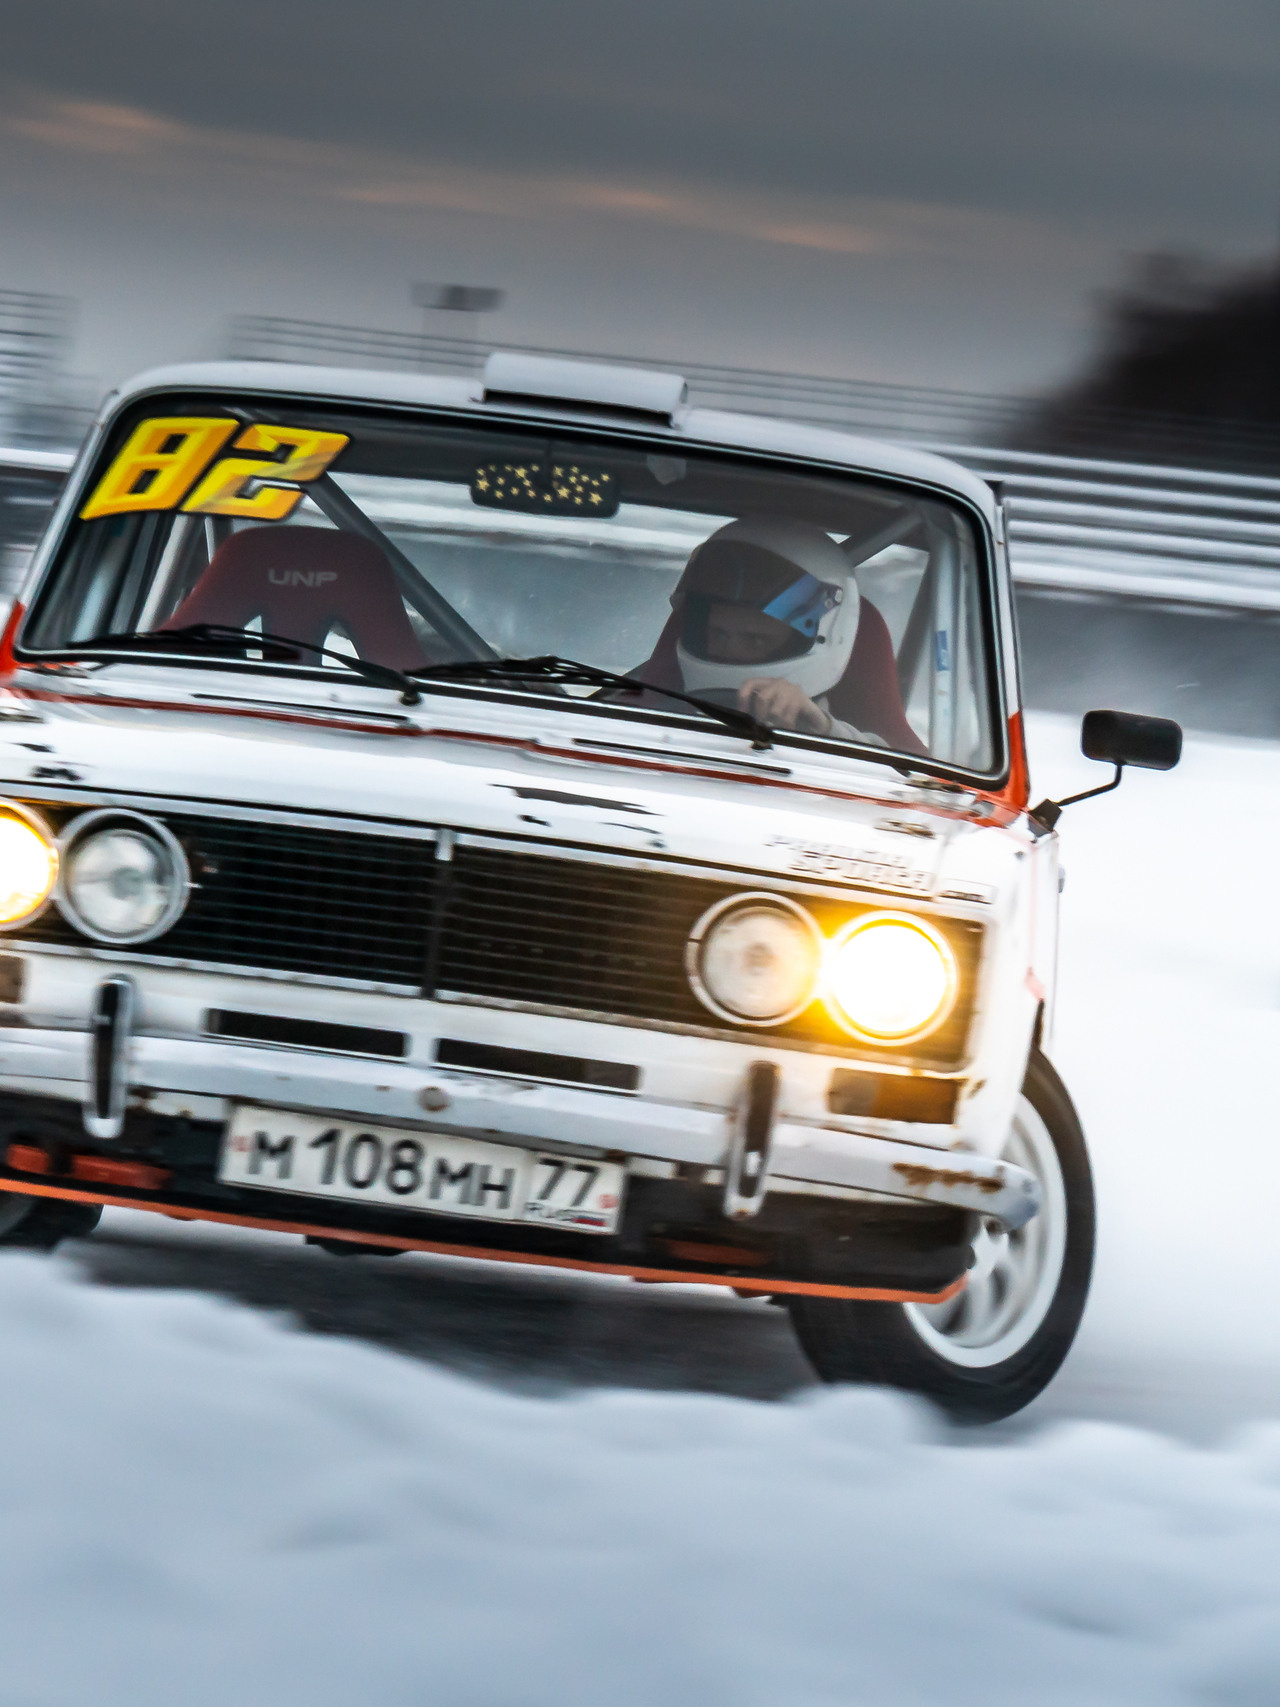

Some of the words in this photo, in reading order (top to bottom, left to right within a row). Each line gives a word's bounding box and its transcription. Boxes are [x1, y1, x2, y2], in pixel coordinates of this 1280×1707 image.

[79, 417, 350, 521] 82
[268, 567, 338, 588] UNP
[536, 1157, 601, 1208] 77
